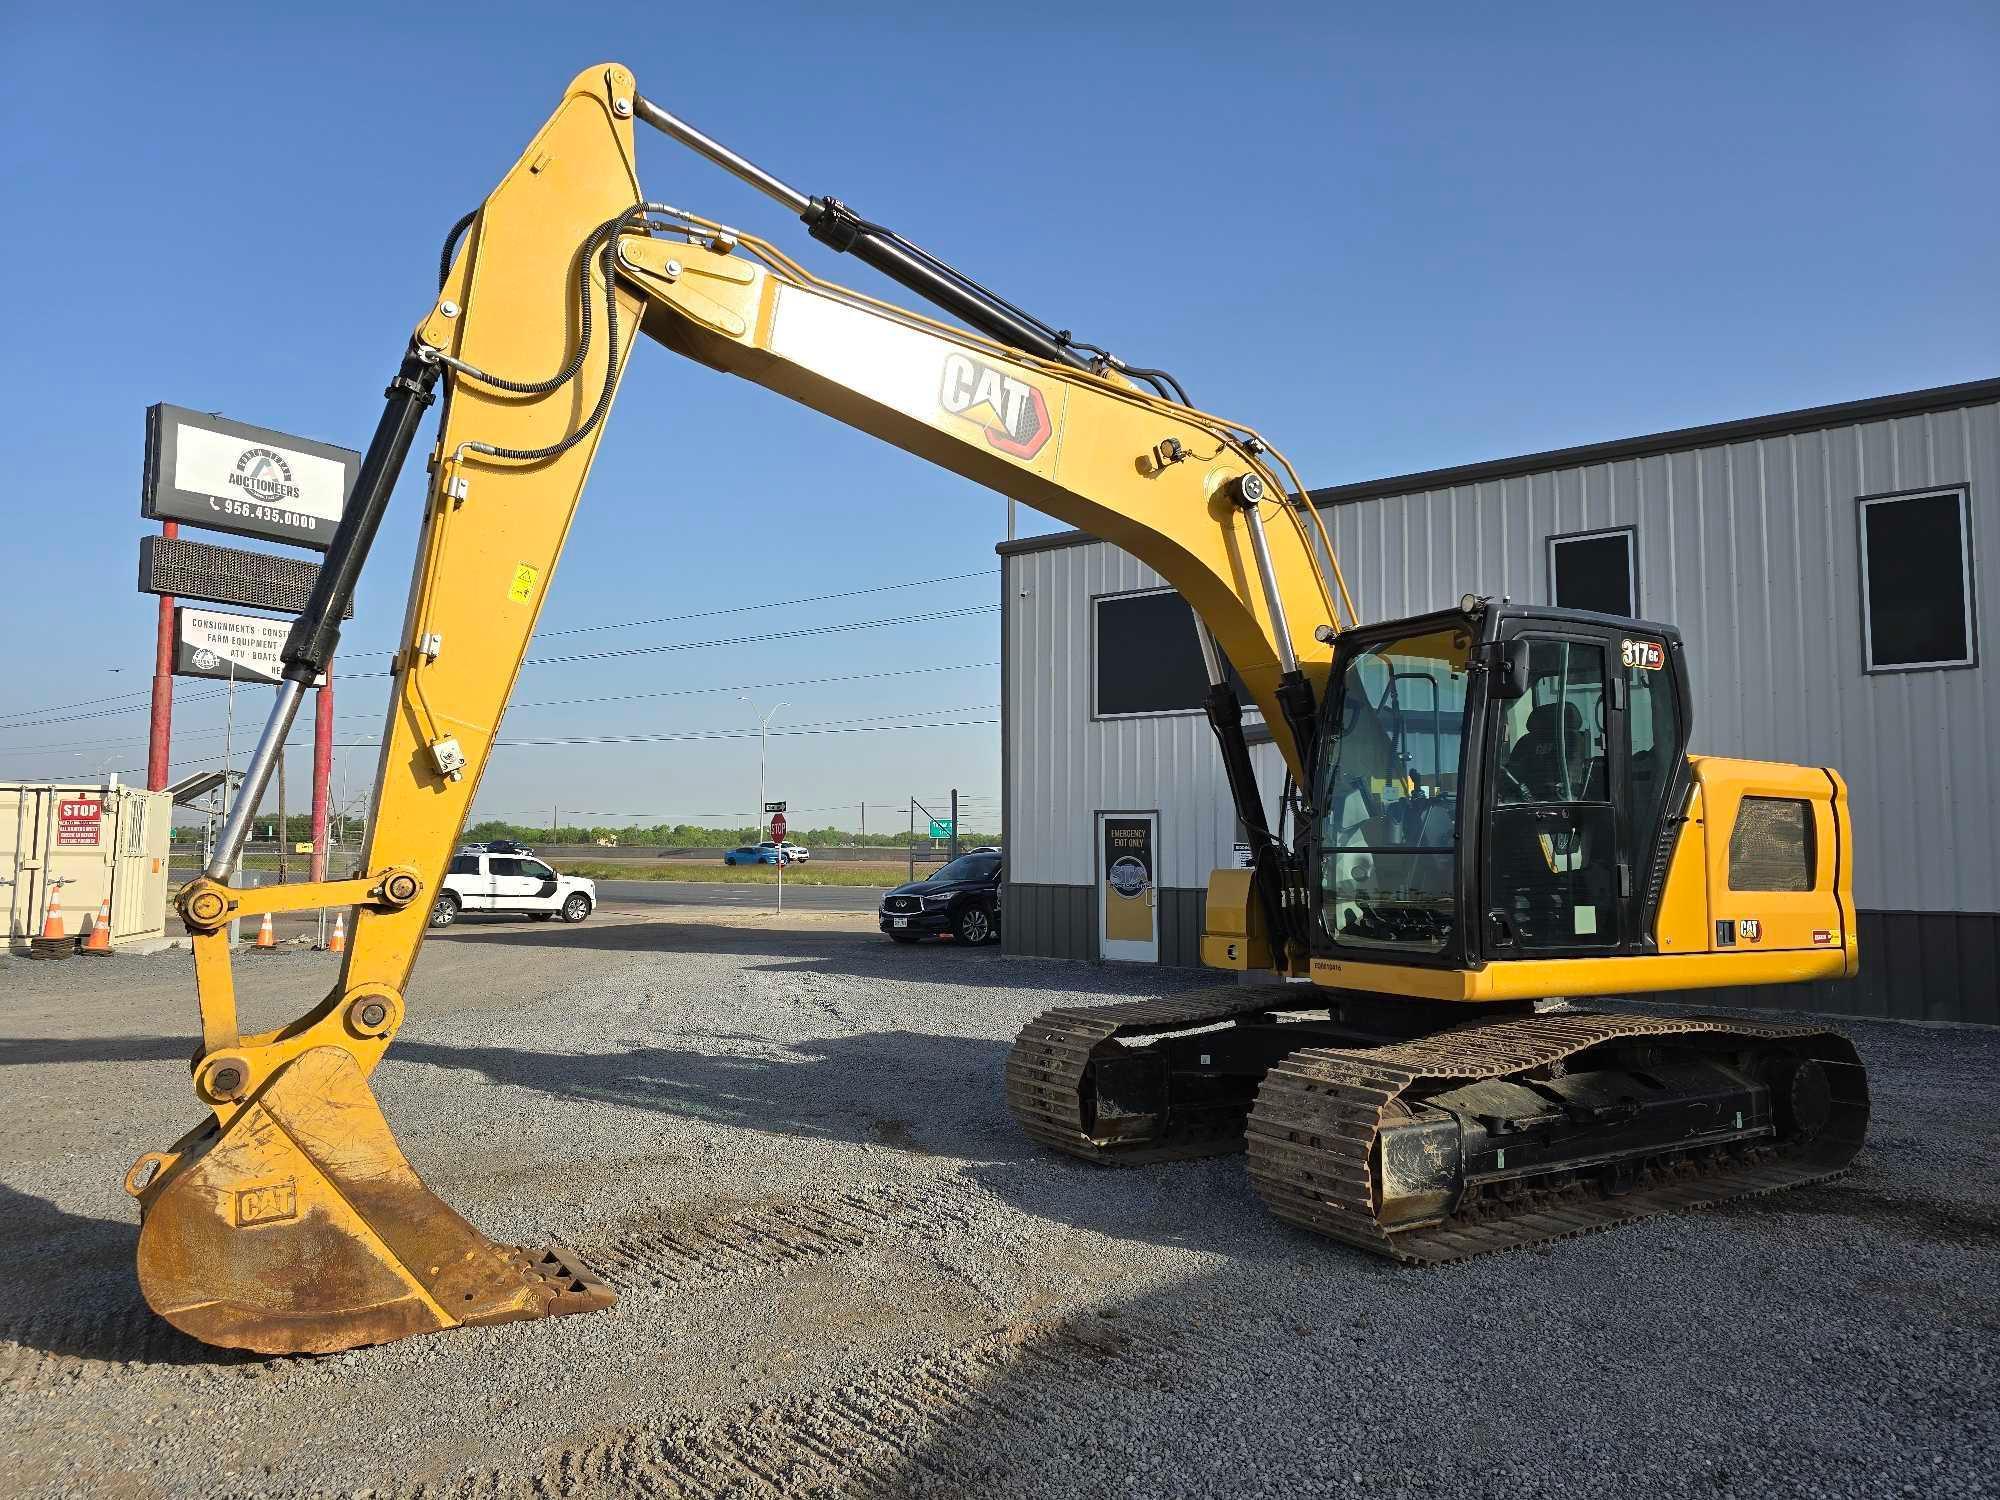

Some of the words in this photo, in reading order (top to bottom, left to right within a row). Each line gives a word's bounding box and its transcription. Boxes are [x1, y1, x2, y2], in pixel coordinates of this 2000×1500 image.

[942, 353, 1030, 437] CAT
[229, 473, 300, 498] AUCTIONEERS
[225, 500, 316, 530] 956.435.0000
[192, 618, 255, 634] CONSIGNMENTS
[207, 633, 229, 644] FARM
[231, 636, 279, 650] EQUIPMENT
[230, 649, 245, 658] ATV
[252, 651, 278, 662] BOATS
[1622, 640, 1649, 666] 317
[1648, 649, 1659, 662] GC
[271, 666, 281, 675] HE
[63, 804, 98, 817] STOP
[771, 823, 786, 835] STOP
[1111, 829, 1146, 838] EMERGENCY
[1114, 838, 1127, 847] EXIT
[1128, 838, 1144, 848] ONLY
[1740, 920, 1758, 938] CAT
[241, 1187, 293, 1221] CAT
